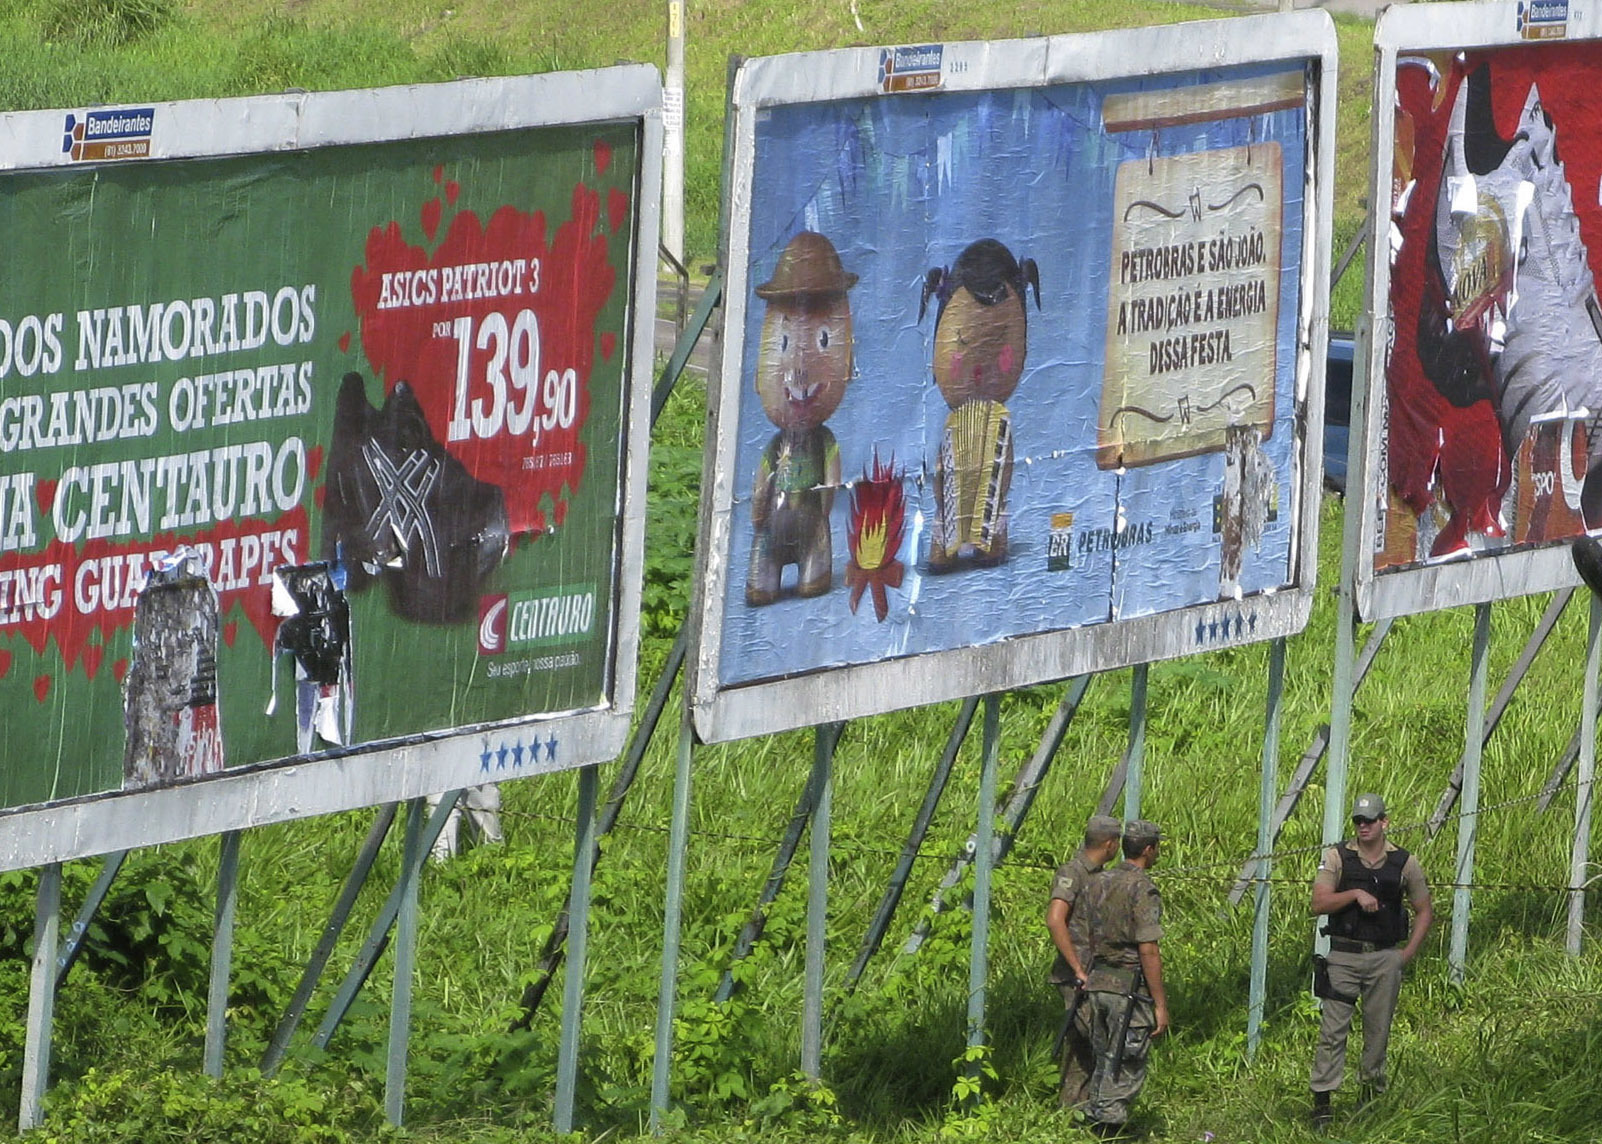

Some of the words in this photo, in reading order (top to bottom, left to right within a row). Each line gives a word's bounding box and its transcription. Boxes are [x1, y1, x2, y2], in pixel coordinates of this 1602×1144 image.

[88, 114, 151, 134] Bandeirantes
[1120, 242, 1194, 284] PETROBRAS
[1197, 241, 1206, 273] E
[1208, 230, 1233, 271] SÃO
[1235, 226, 1266, 268] JOÃO.
[377, 268, 437, 309] ASICS
[441, 259, 526, 302] PATRIOT
[529, 258, 540, 293] 3
[1116, 301, 1127, 335] A
[1131, 287, 1191, 334] TRADIÇÃO
[1194, 283, 1203, 323] É
[1204, 289, 1214, 322] A
[1217, 280, 1266, 320] ENERGIA
[75, 284, 315, 371] NAMORADOS
[432, 321, 451, 338] POR
[1150, 335, 1187, 375] DESSA
[1190, 329, 1232, 367] FESTA.
[0, 381, 158, 452] GRANDES
[169, 361, 313, 433] OFERTAS
[53, 436, 306, 543] CENTAURO
[1050, 533, 1069, 558] BR
[1078, 520, 1153, 553] PETROBRAS
[510, 592, 593, 642] CENTAURO
